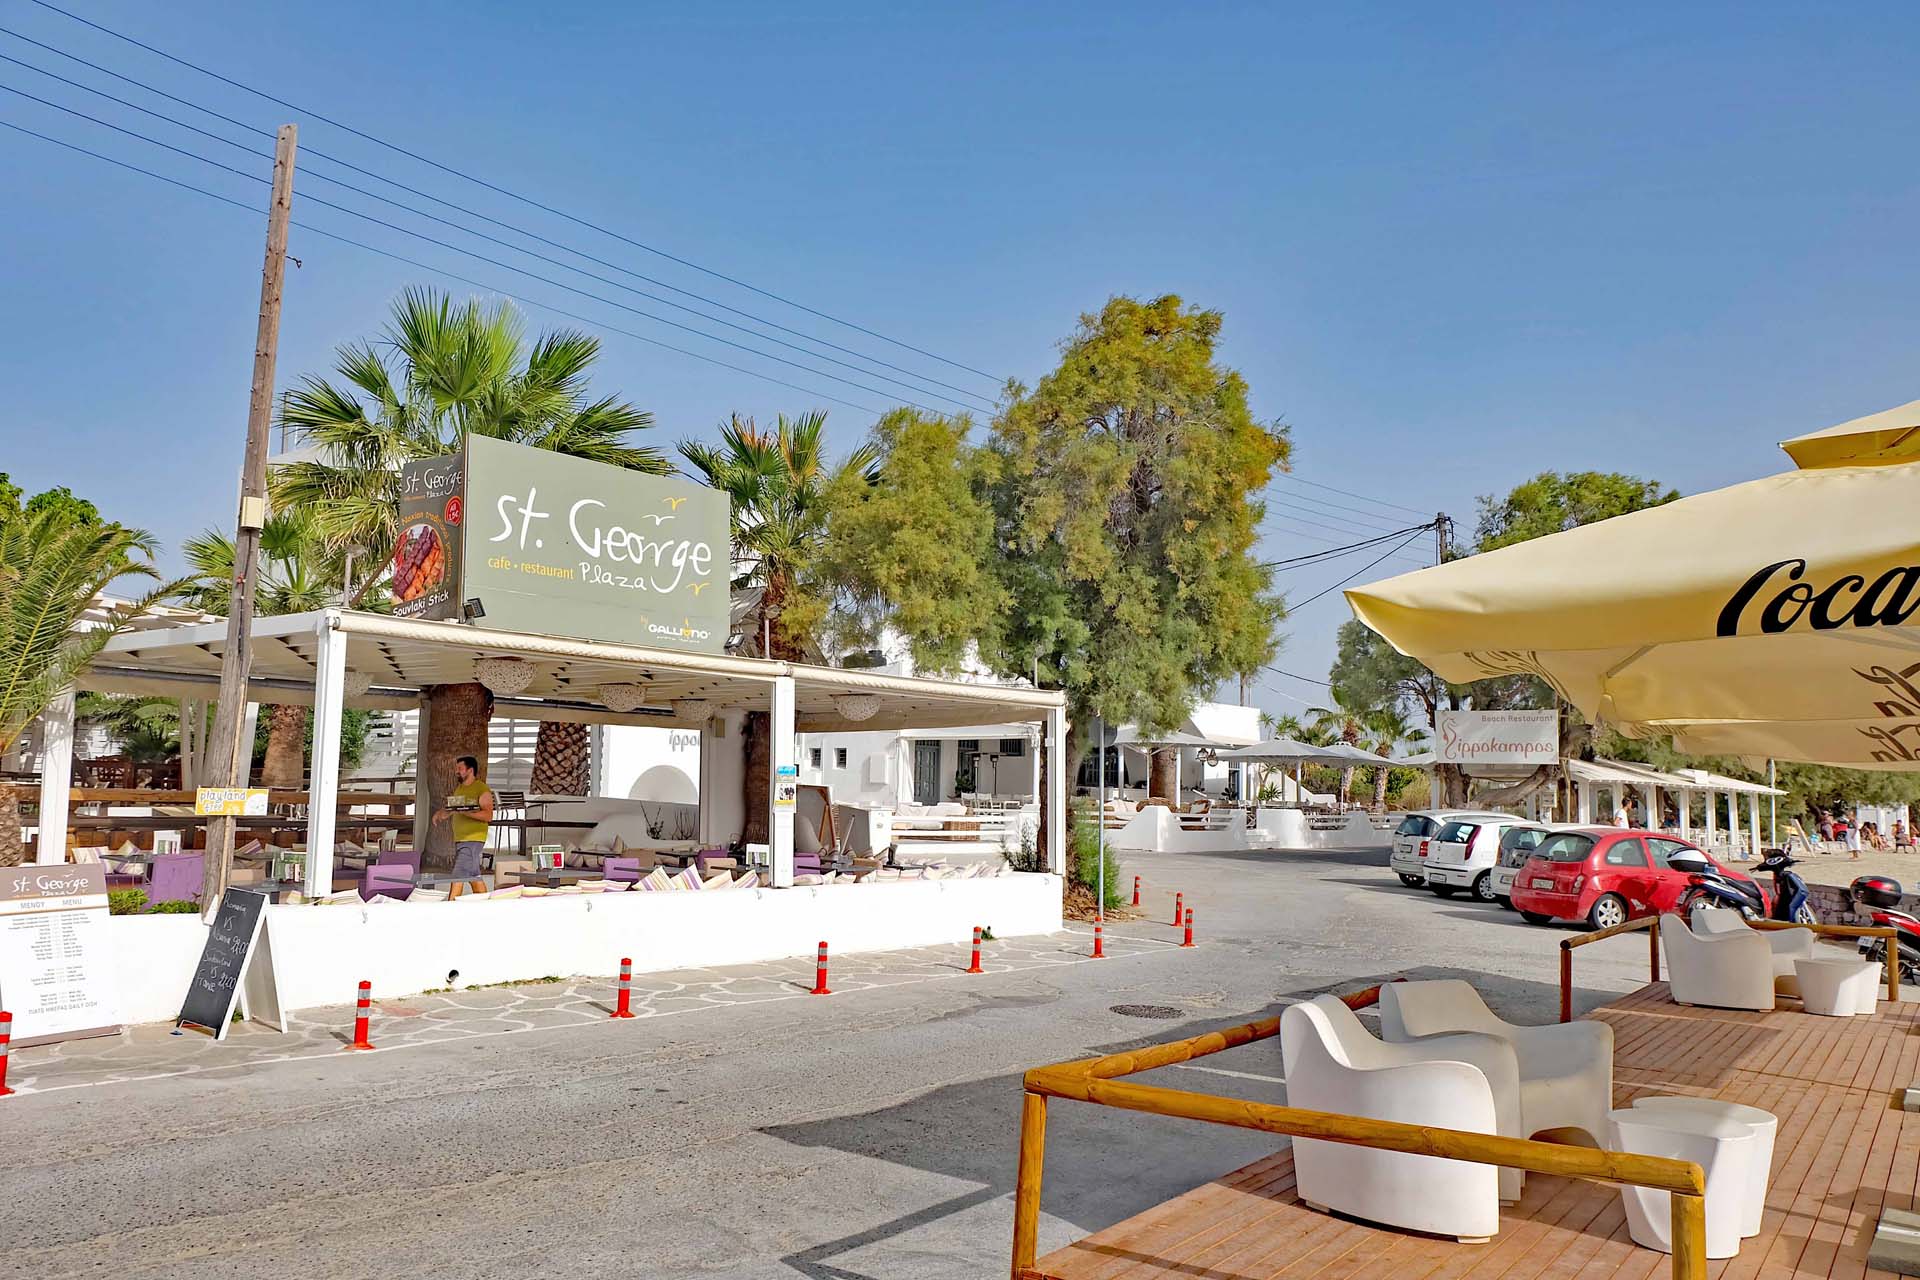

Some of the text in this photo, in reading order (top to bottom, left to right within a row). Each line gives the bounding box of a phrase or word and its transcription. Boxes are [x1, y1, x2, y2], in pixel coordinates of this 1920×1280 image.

[404, 468, 462, 495] St. George
[490, 487, 712, 594] St. George
[488, 556, 574, 580] cafe restaurant
[578, 561, 648, 591] Plaza
[393, 597, 426, 617] Souvlaki
[428, 589, 449, 607] Stick
[1481, 714, 1553, 723] Beach Restaurant
[668, 730, 701, 752] ippo
[12, 875, 89, 895] St. George
[62, 898, 82, 906] MENU
